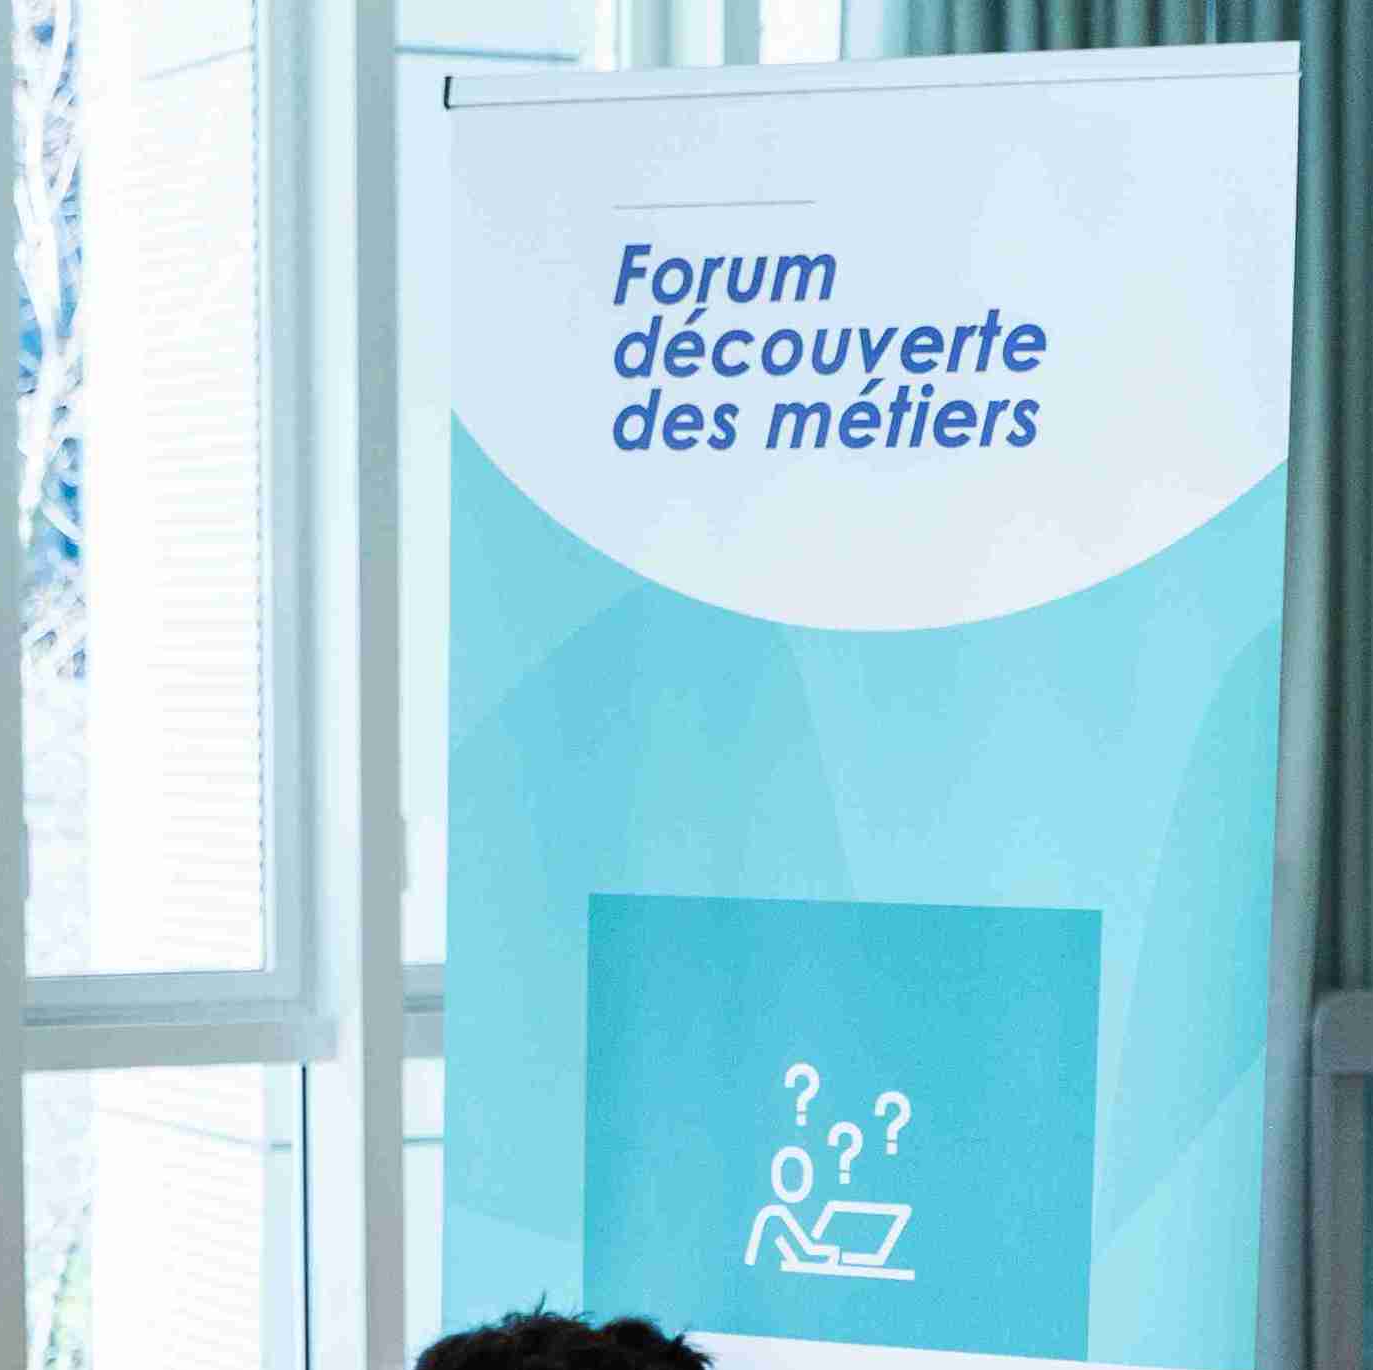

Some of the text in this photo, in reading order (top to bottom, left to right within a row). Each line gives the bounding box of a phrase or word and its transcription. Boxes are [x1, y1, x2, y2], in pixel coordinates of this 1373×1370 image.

[613, 243, 837, 305] Forum
[613, 307, 1047, 378] découverte
[612, 377, 1040, 450] des métiers
